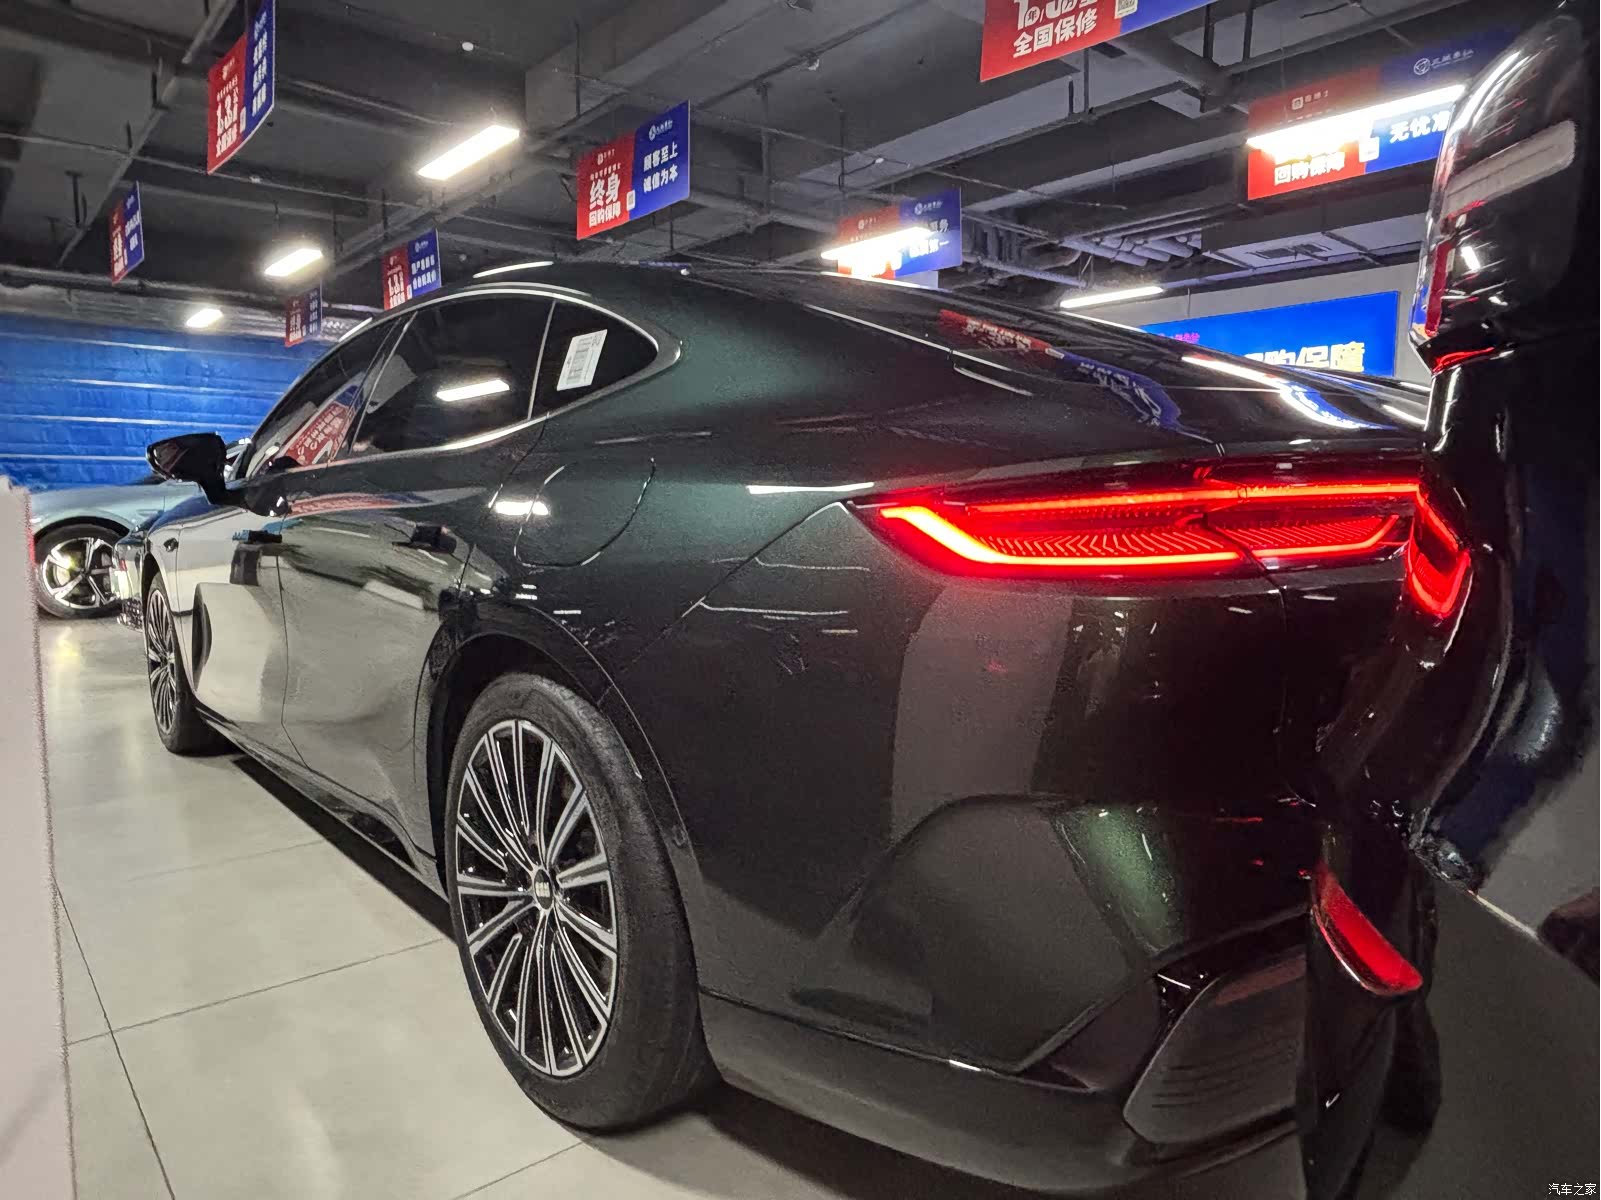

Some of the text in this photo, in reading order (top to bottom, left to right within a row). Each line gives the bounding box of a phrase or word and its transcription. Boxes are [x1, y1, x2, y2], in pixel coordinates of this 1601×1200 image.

[1013, 8, 1098, 59] 全国保修
[643, 141, 679, 172] 顾客至上
[589, 172, 621, 210] 终身
[643, 164, 679, 194] 诚信为本
[588, 200, 621, 228] 回购保障
